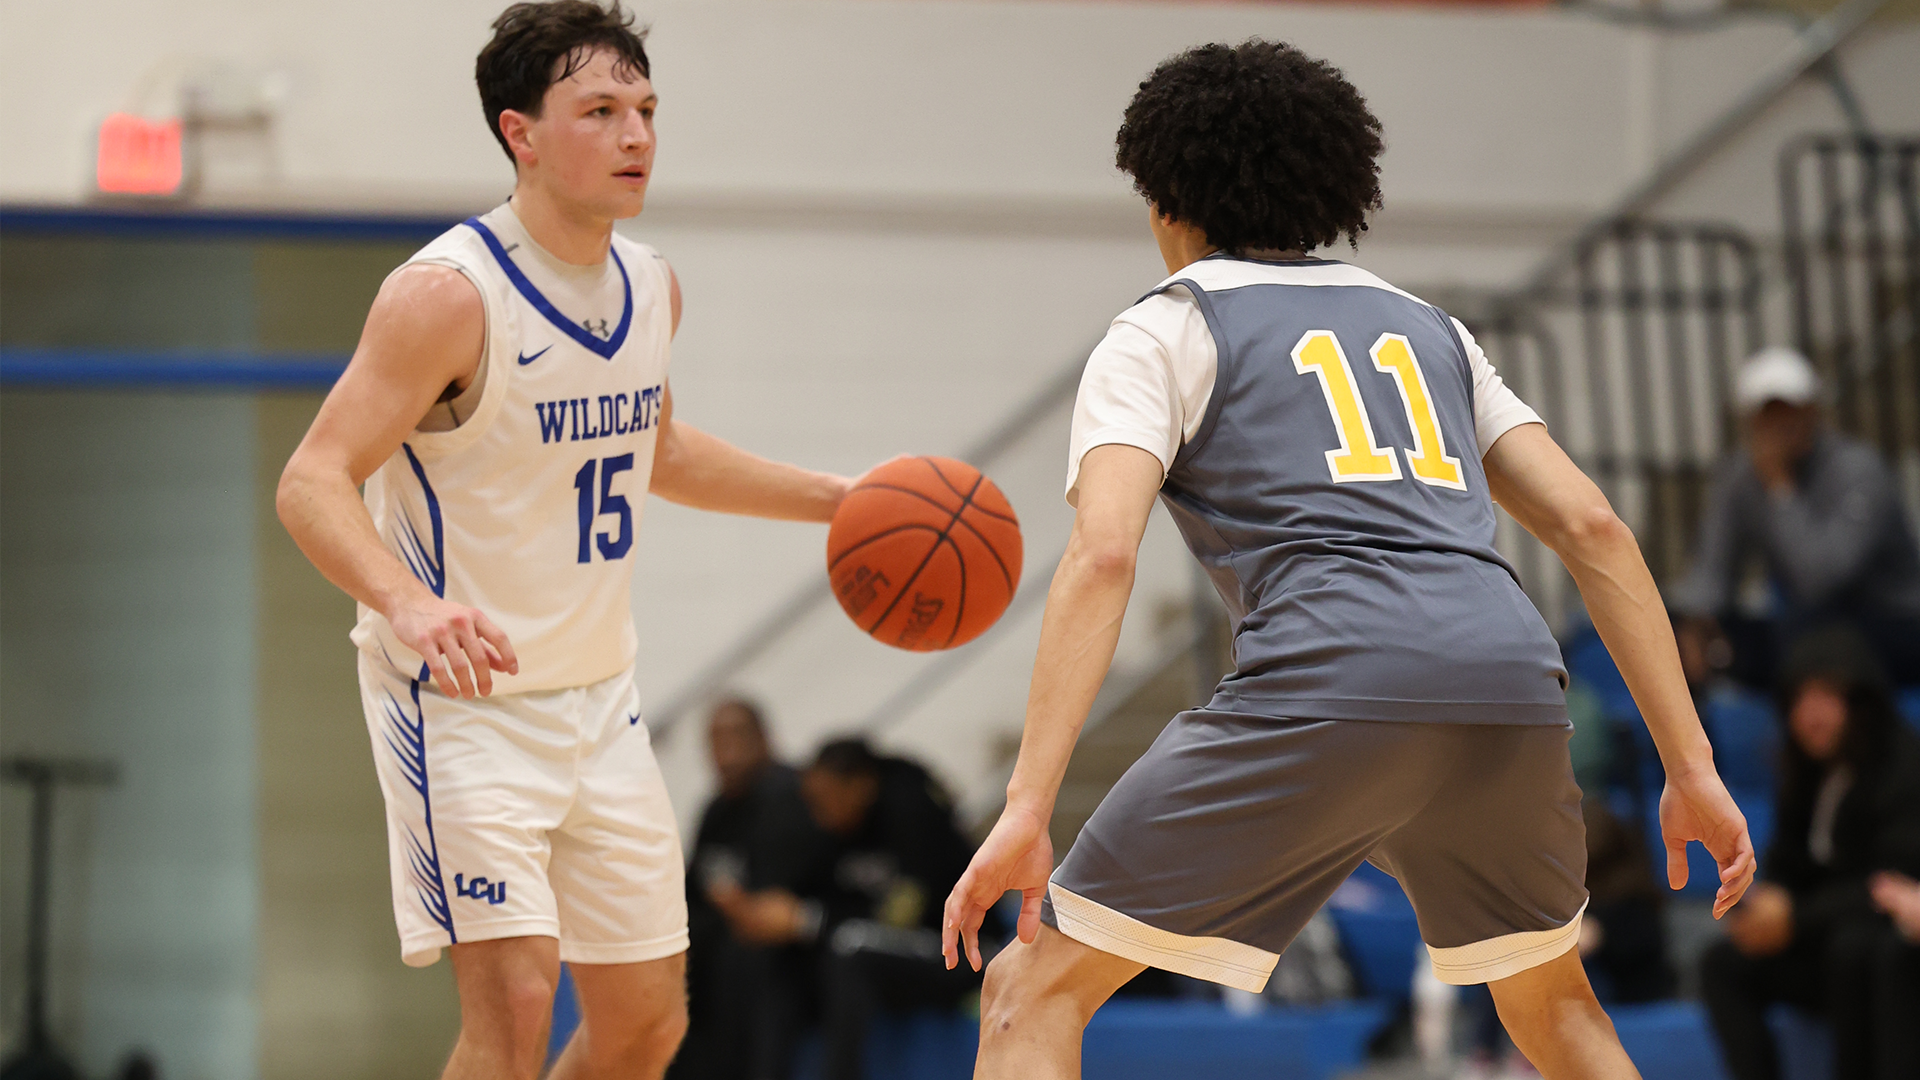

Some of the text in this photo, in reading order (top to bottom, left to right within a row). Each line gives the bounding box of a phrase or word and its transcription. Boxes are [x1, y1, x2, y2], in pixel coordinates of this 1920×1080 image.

[1290, 329, 1467, 492] 11
[573, 452, 634, 564] 15
[454, 872, 506, 906] LCU
